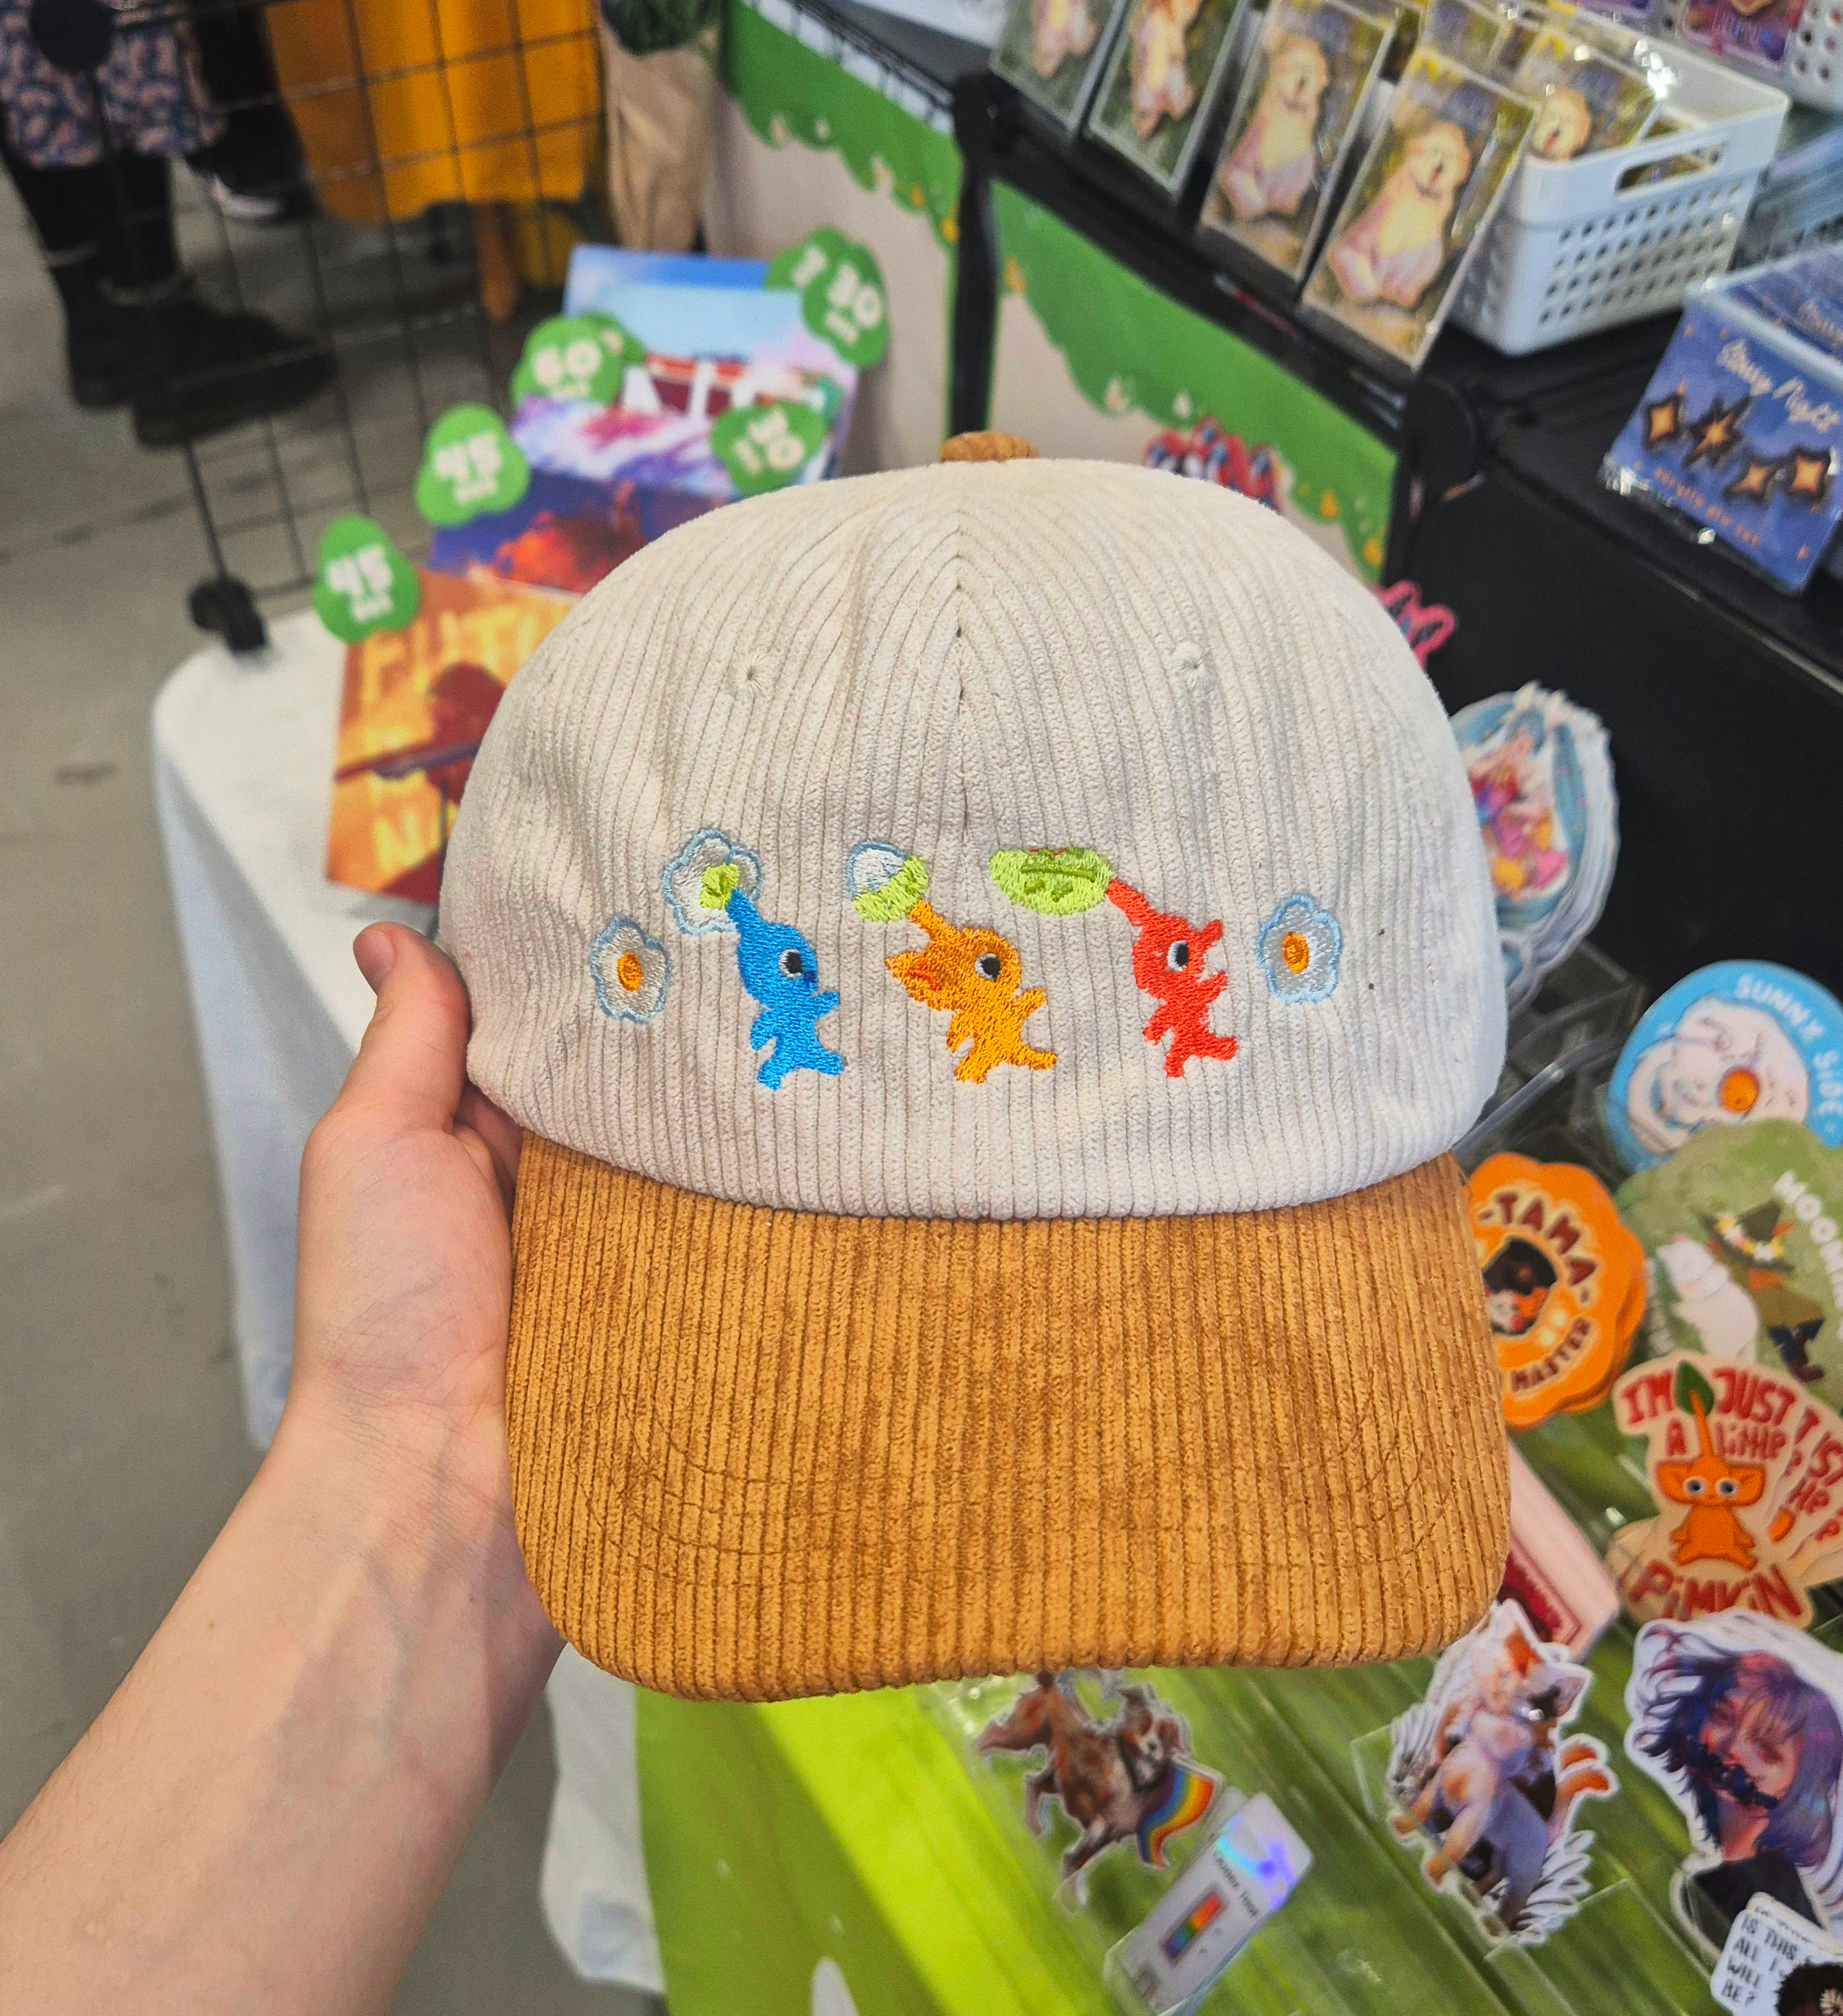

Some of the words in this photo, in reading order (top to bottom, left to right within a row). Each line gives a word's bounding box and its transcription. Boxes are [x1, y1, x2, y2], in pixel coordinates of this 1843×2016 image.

[1735, 974, 1825, 1043] SUNNY
[1512, 1317, 1590, 1393] MASTER
[1712, 1367, 1796, 1426] JUST
[1665, 1419, 1688, 1456] A
[1741, 1915, 1759, 1935] IS
[1733, 1937, 1759, 1962] ALL
[1728, 1955, 1760, 1988] WILL
